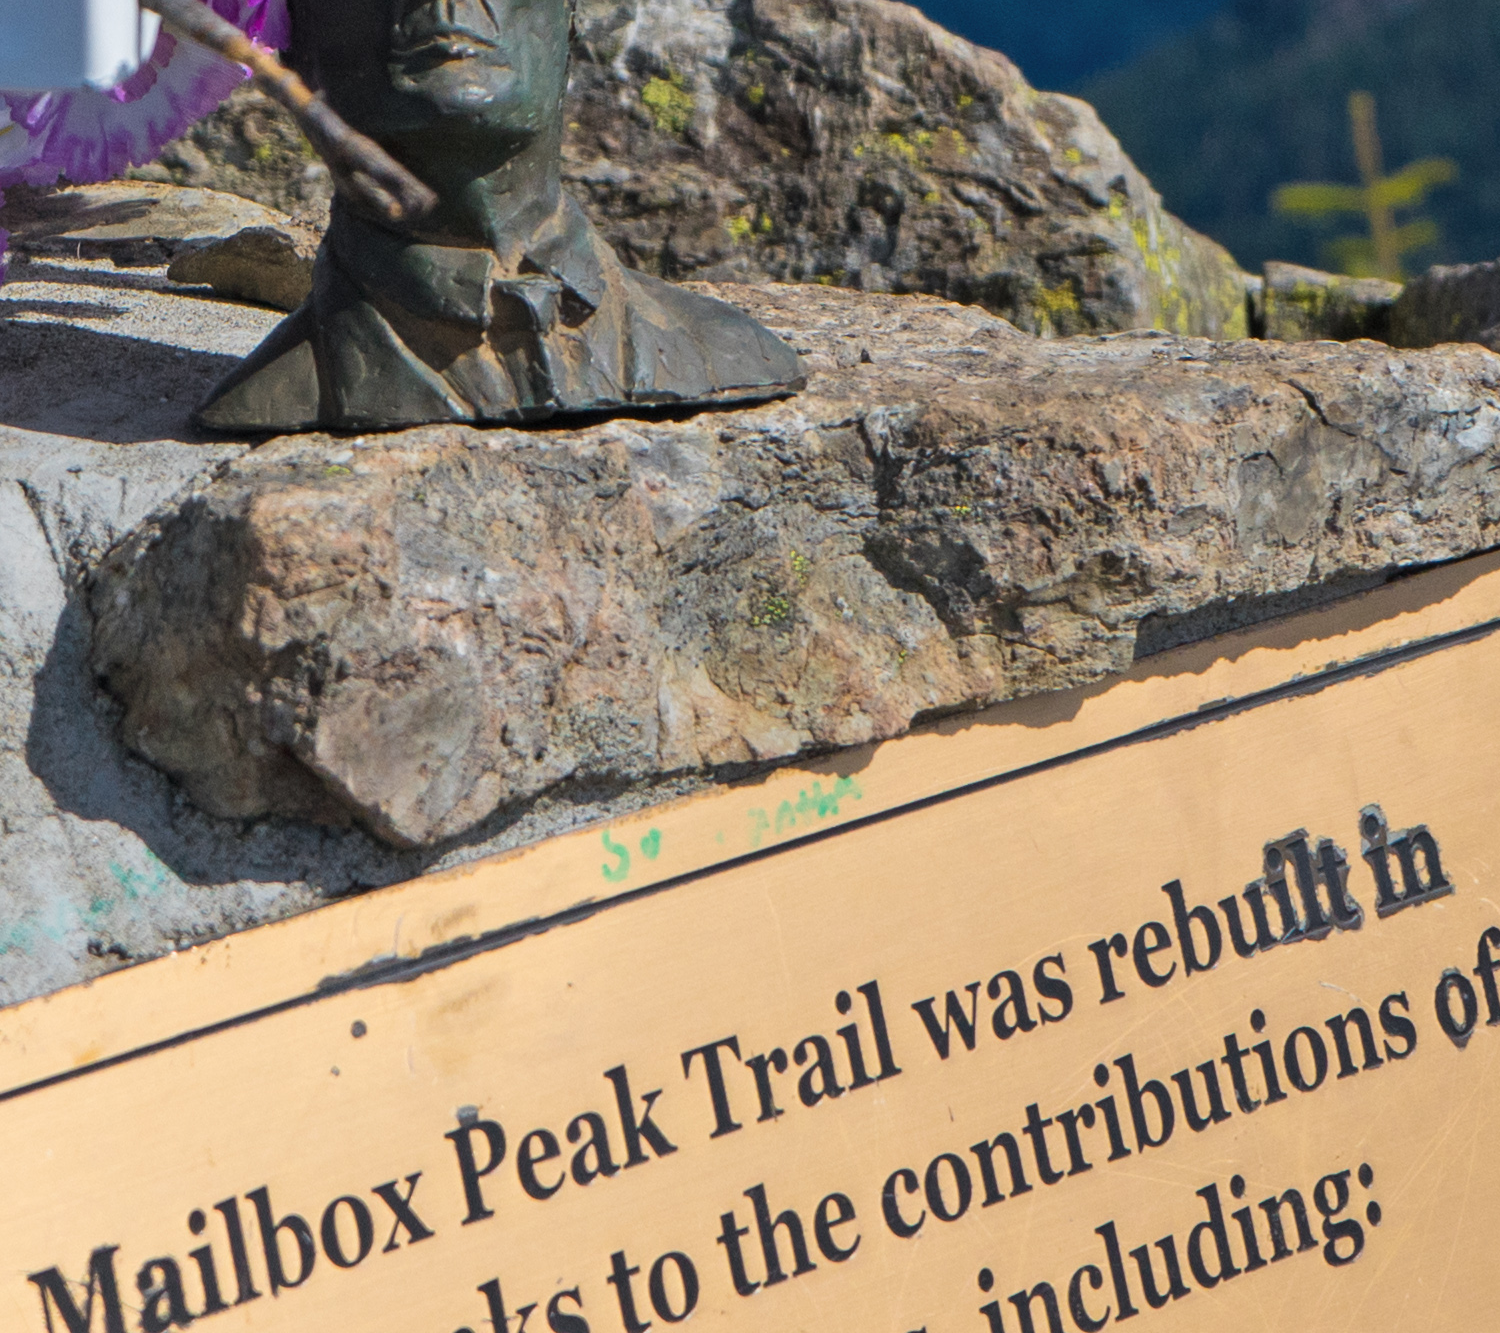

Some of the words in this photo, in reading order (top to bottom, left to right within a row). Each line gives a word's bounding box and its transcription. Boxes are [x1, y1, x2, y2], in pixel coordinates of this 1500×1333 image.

[27, 1171, 436, 1333] Mailbox
[444, 1064, 680, 1227] Peak
[680, 979, 903, 1140] Trail
[911, 951, 1075, 1062] was
[1087, 827, 1366, 1006] rebuilt
[1359, 802, 1457, 920] in
[605, 1248, 700, 1333] to
[715, 1182, 862, 1298] the
[880, 989, 1418, 1240] contributions
[979, 1162, 1383, 1333] including:
